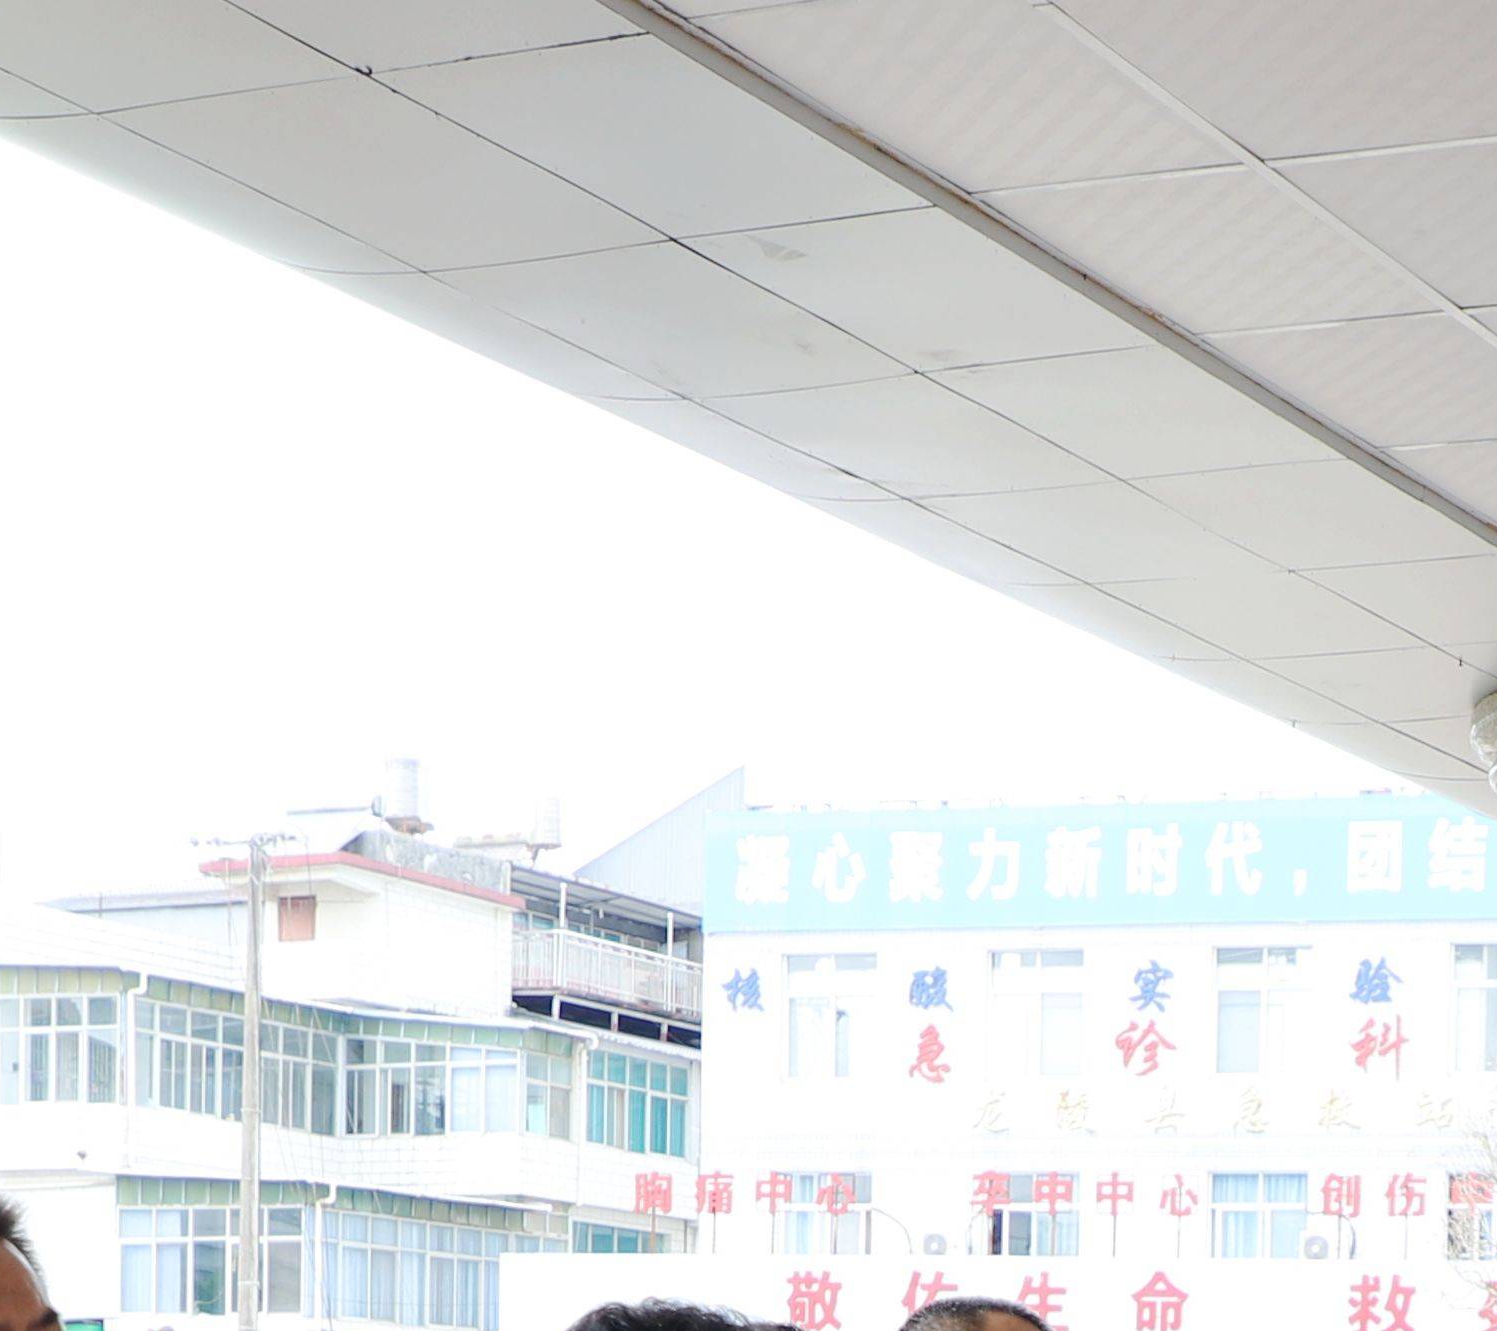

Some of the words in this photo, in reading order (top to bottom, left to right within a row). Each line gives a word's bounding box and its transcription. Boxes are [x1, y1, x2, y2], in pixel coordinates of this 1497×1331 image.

[721, 956, 1404, 1013] 核酸实验
[907, 1015, 1410, 1083] 急诊科
[632, 1170, 856, 1216] 胸痛中心
[969, 1170, 1199, 1216] 卒中中心
